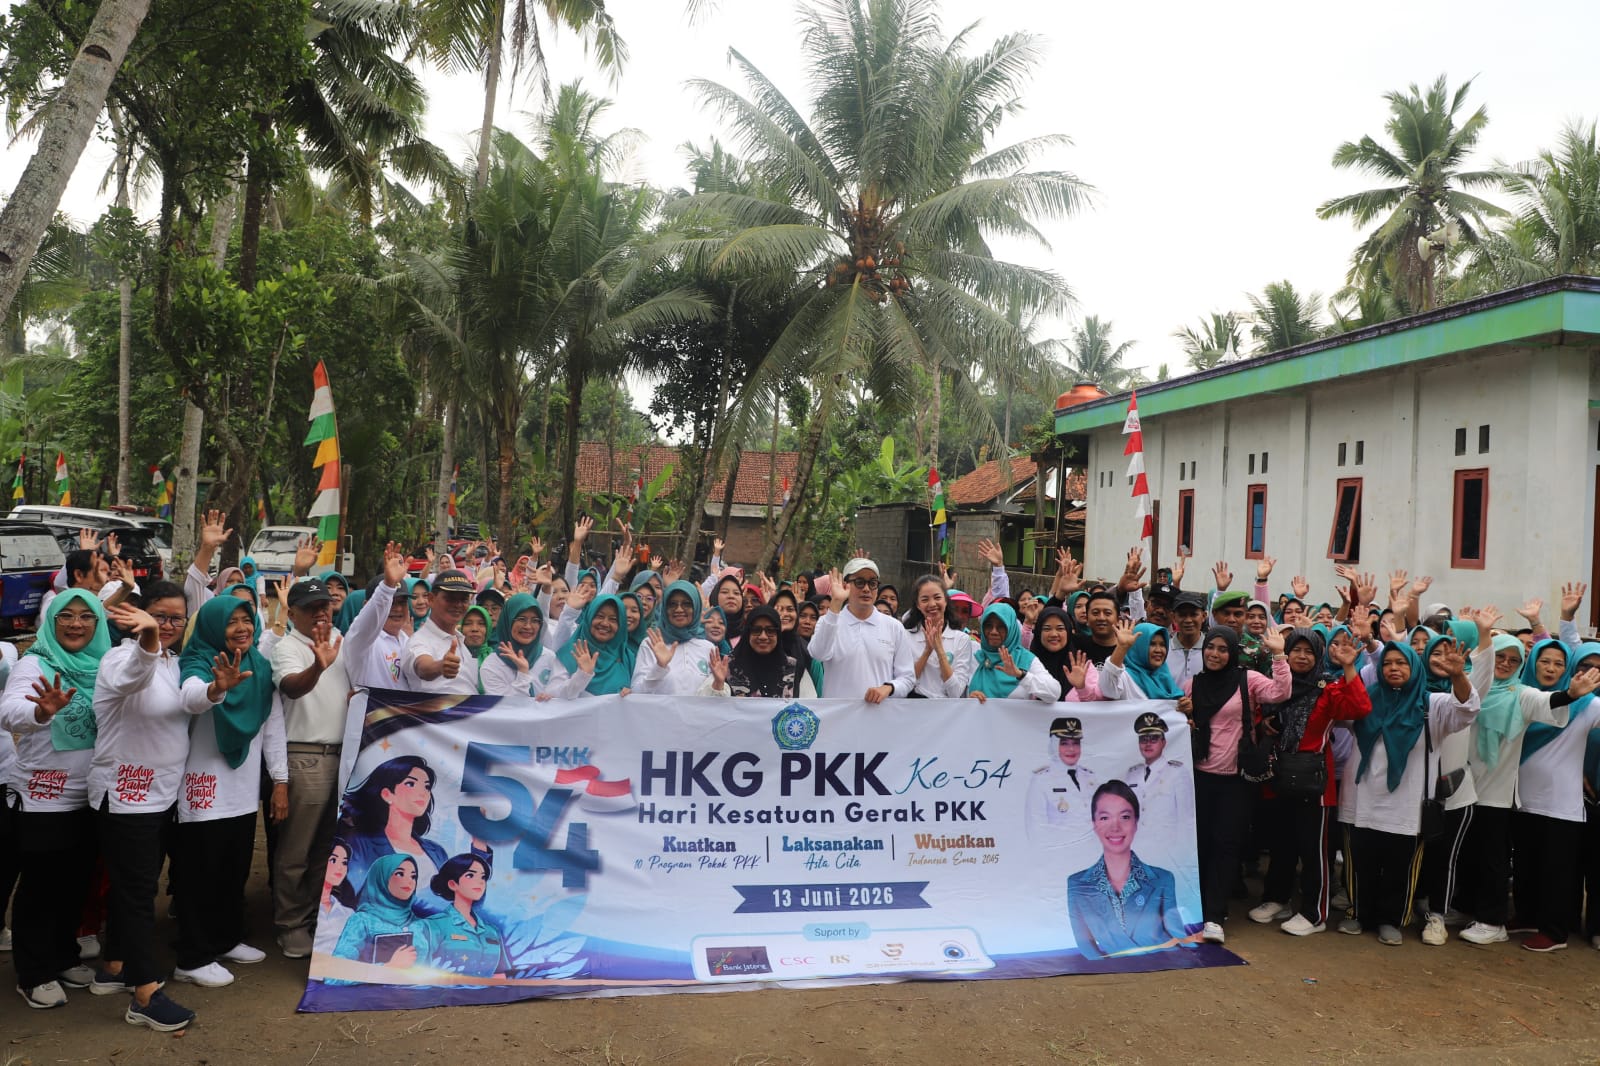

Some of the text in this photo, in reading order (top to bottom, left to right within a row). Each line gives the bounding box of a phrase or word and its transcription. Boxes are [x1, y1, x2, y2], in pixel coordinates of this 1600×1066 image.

[536, 746, 590, 765] PKK
[118, 764, 155, 780] Hidup
[185, 771, 217, 788] Hidup
[640, 750, 1012, 797] HKG PKK Ke-54
[116, 776, 154, 795] Jaya!
[185, 782, 217, 801] Jaya!
[30, 791, 61, 800] PKK
[119, 792, 148, 803] PKK
[189, 800, 213, 811] PKK
[458, 741, 599, 888] 54
[638, 800, 988, 824] Hari Kesatuan Gerak PKK
[662, 835, 737, 853] Kuatkan
[782, 835, 884, 852] Laksanakan
[914, 833, 996, 852] Wujudkan
[633, 854, 762, 874] 10 Program Pokok PKK
[803, 852, 861, 871] Asta Cita
[905, 851, 1000, 867] Indonesia Emas 2045
[772, 886, 894, 908] 13 Juni 2026
[814, 926, 860, 939] Suport by
[780, 955, 816, 966] CSC
